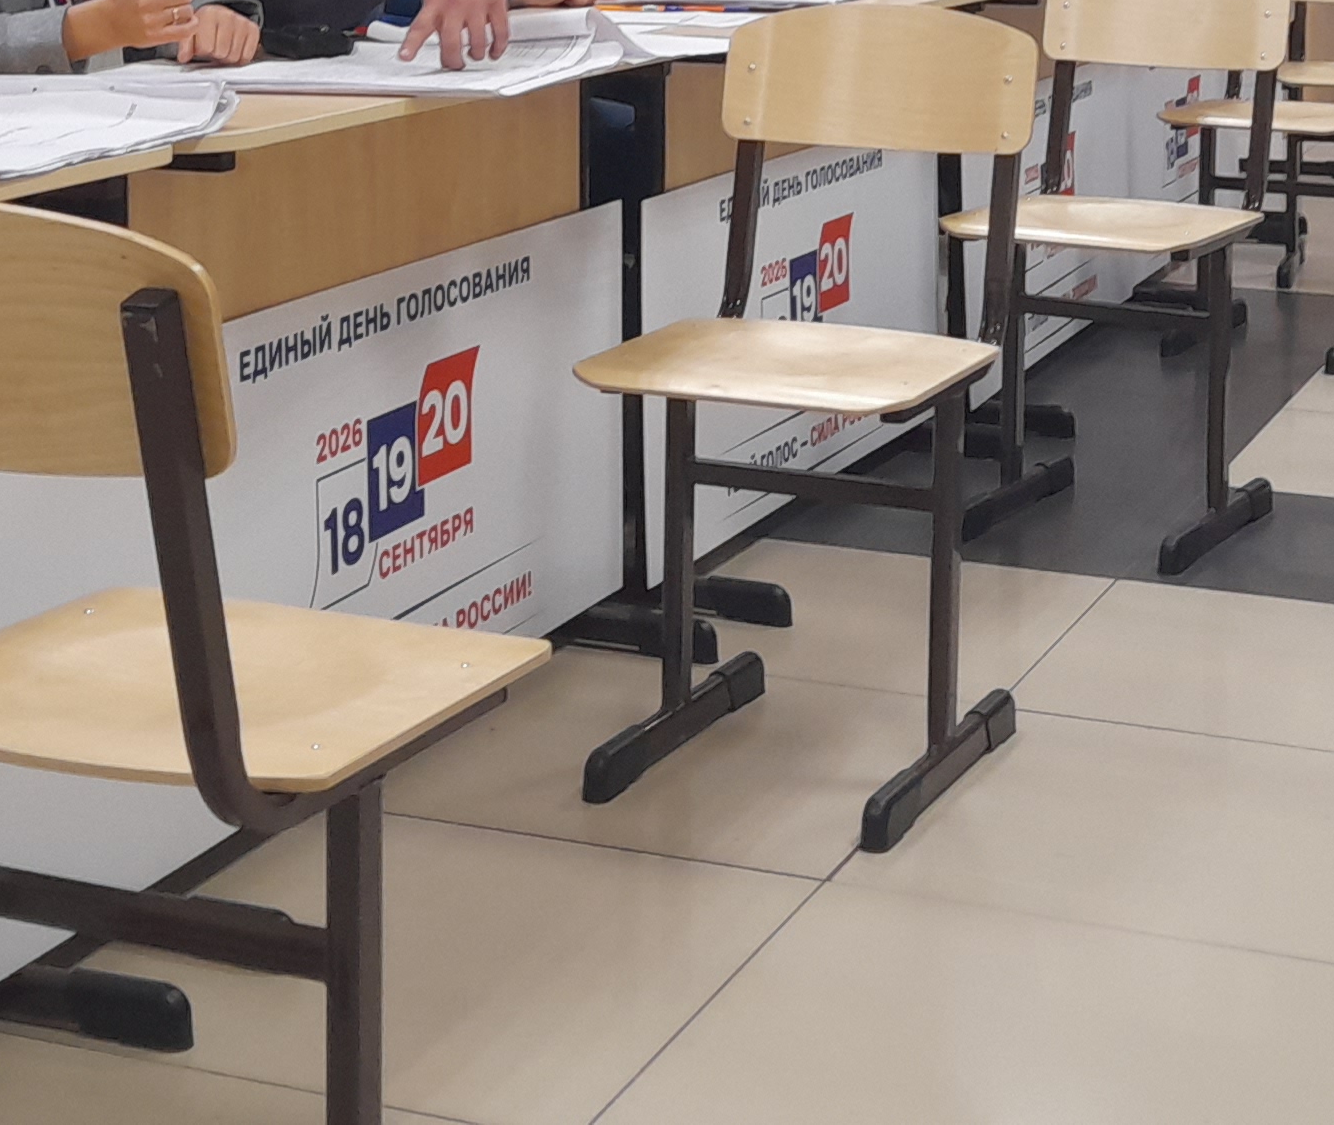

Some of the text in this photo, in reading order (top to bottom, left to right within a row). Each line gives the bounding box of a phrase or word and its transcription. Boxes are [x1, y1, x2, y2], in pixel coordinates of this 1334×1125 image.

[719, 148, 883, 224] ЕДЙ ДЕНЬ ГОЛОСОВАНИЯ
[760, 257, 787, 288] 2026
[792, 236, 848, 322] 19 20
[238, 255, 531, 384] ЕДИНЫЙ ДЕНЬ ГОЛОСОВАНИЯ
[316, 418, 364, 464] 2026
[323, 379, 469, 575] 18 19 20
[378, 506, 474, 580] СЕНТЯБРЯ
[455, 570, 533, 629] РОССИИ!
